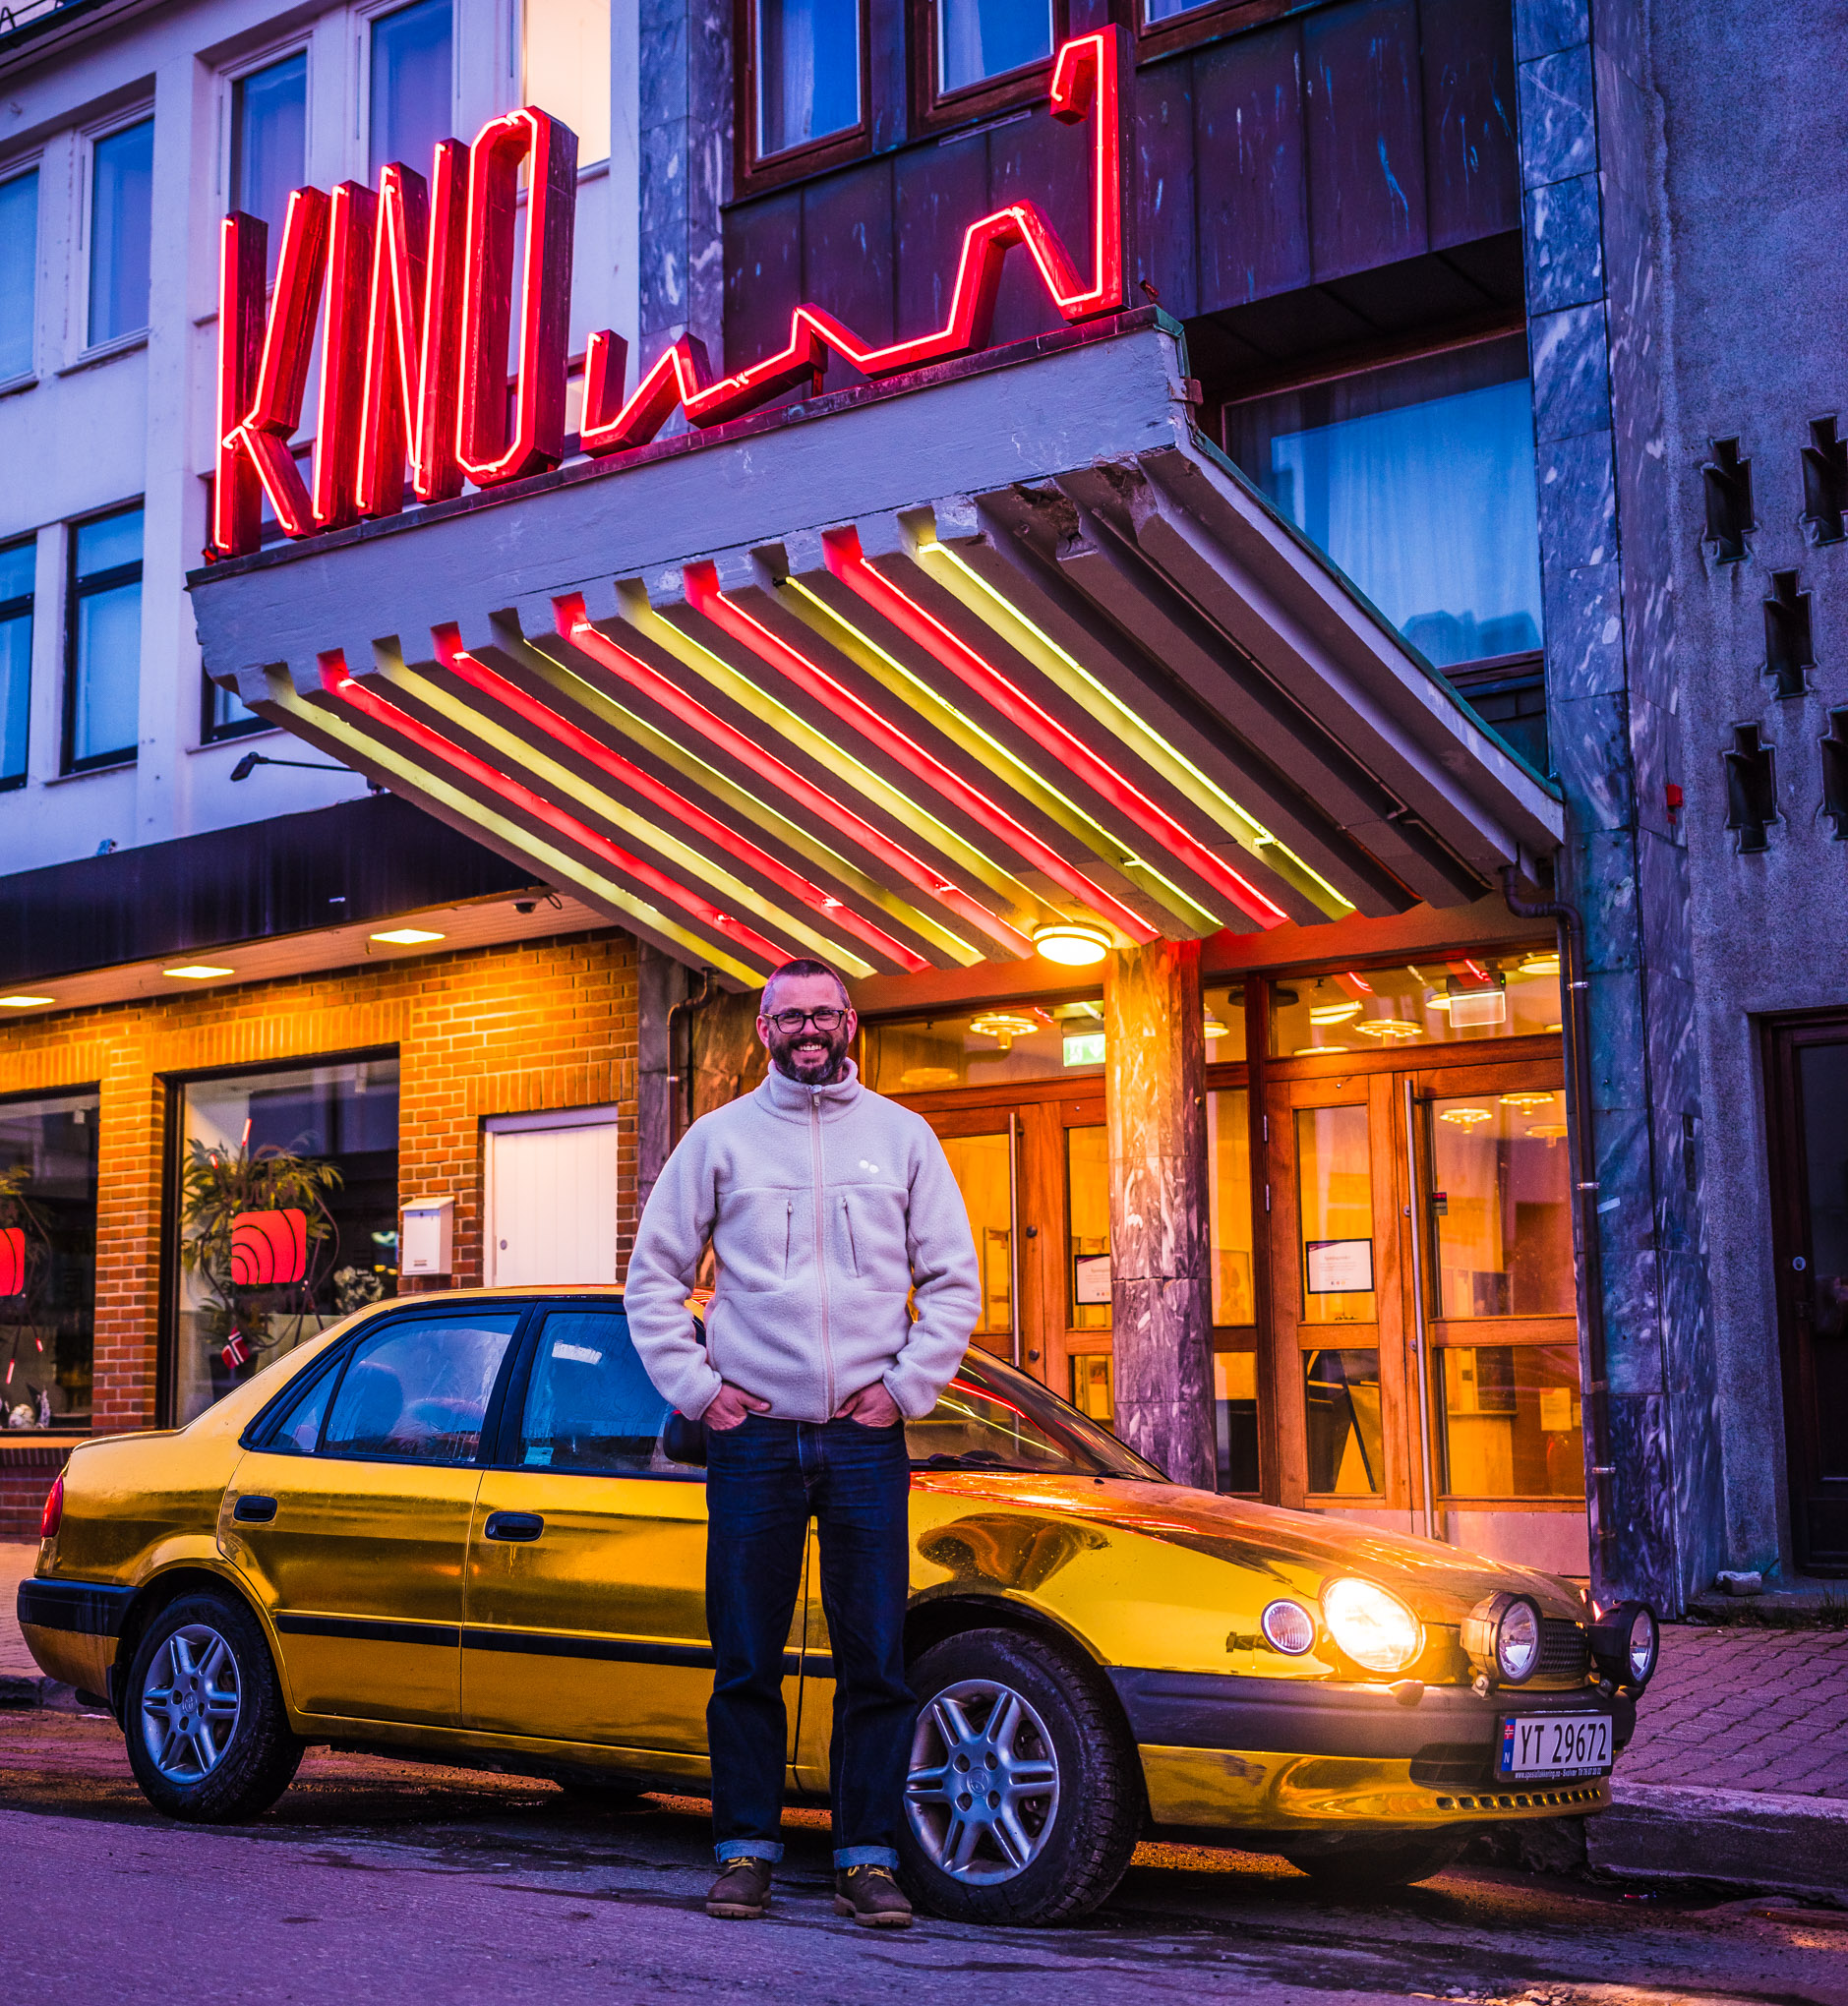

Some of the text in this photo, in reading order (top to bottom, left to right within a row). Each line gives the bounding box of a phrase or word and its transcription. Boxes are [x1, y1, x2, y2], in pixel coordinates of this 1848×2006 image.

[213, 105, 578, 557] KINO
[1504, 1752, 1510, 1763] N
[1520, 1723, 1607, 1764] YT 29672
